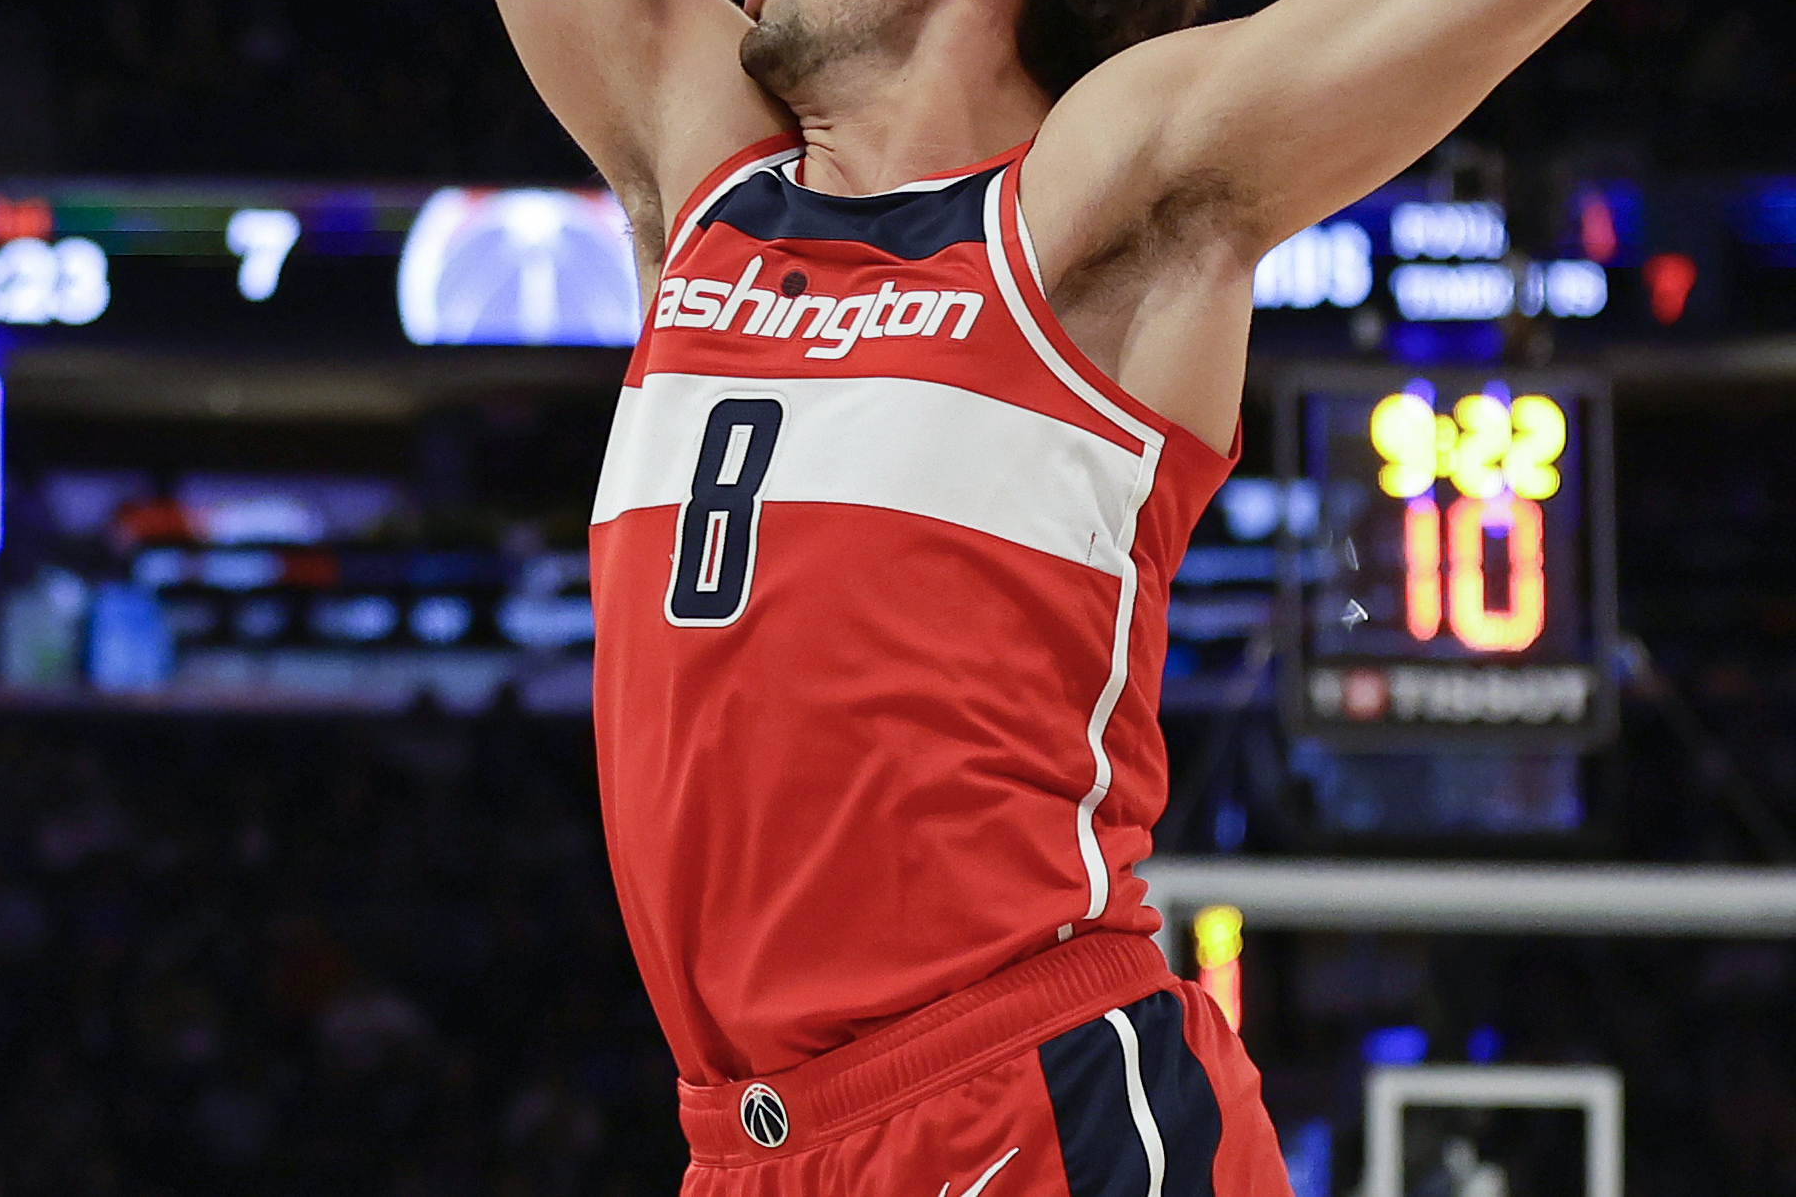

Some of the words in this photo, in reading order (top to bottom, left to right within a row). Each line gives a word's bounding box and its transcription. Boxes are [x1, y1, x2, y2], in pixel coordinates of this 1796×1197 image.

[227, 208, 301, 301] 7
[654, 254, 984, 359] ashington
[1371, 393, 1566, 500] 9:22
[663, 390, 792, 629] 8
[1404, 497, 1545, 652] 10
